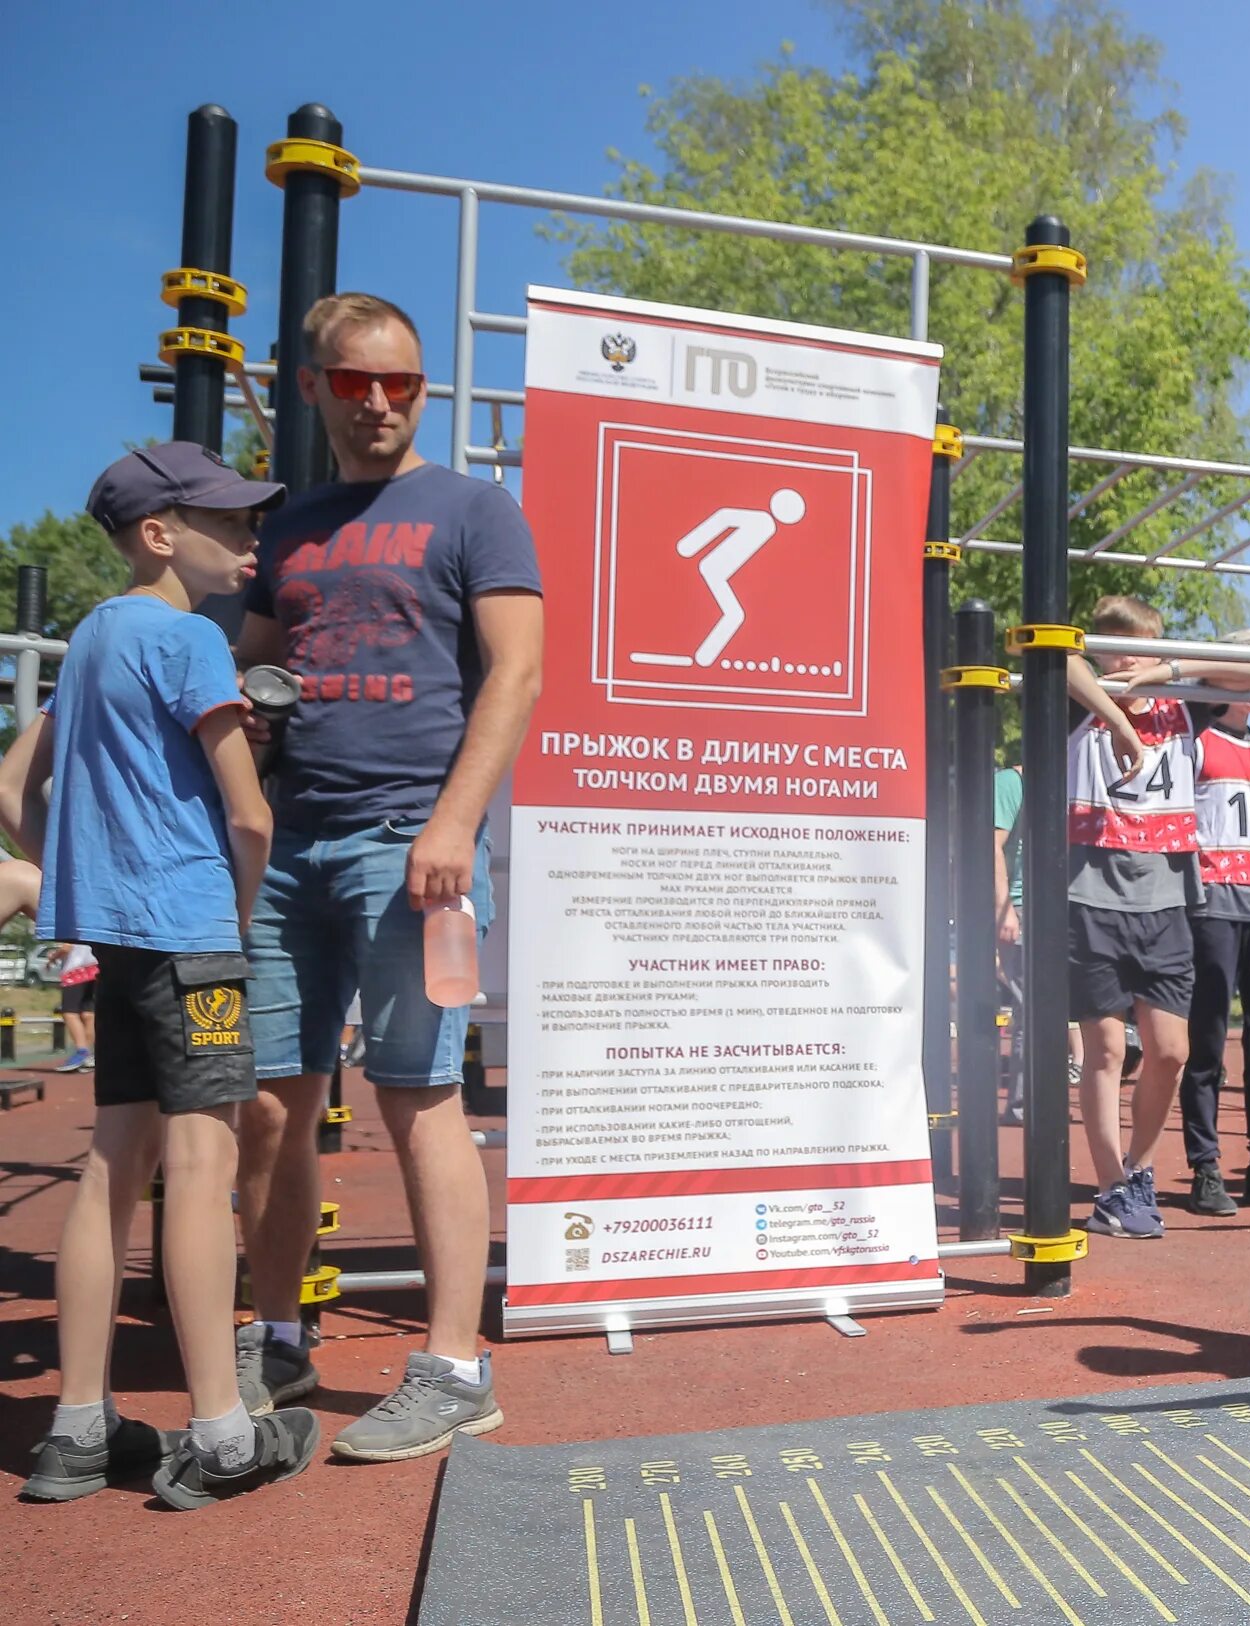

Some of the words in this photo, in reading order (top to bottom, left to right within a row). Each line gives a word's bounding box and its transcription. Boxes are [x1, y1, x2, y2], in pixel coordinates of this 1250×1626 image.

[686, 345, 757, 398] ГТО
[541, 732, 670, 761] ПРЫЖОК
[676, 737, 694, 762] В
[700, 738, 799, 766] ДЛИНУ
[803, 743, 819, 767] С
[824, 743, 908, 770] МЕСТА
[572, 769, 687, 793] ТОЛЧКОМ
[693, 773, 778, 796] ДВУМЯ
[785, 777, 878, 800] НОГАМИ
[537, 821, 621, 837] УЧАСТНИК
[626, 823, 725, 840] ПРИНИМАЕТ
[729, 825, 810, 842] ИСХОДНОЕ
[814, 827, 910, 844] ПОЛОЖЕНИЕ:
[628, 959, 710, 972] УЧАСТНИК
[714, 959, 768, 972] ИМЕЕТ
[772, 958, 825, 971] ПРАВО:
[191, 1031, 240, 1046] SPORT
[605, 1045, 684, 1060] ПОПЫТКА
[688, 1045, 709, 1059] НЕ
[713, 1042, 846, 1058] ЗАСЧИТЫВАЕТСЯ:
[603, 1216, 713, 1235] +79200036111
[602, 1246, 711, 1265] DSZARECHIE.RU
[1100, 1415, 1150, 1435] 200
[1161, 1409, 1209, 1428] 190
[976, 1428, 1025, 1450] 220
[1038, 1421, 1088, 1443] 210
[847, 1442, 892, 1463] 240
[912, 1435, 959, 1456] 230
[710, 1455, 752, 1478] 260
[779, 1448, 823, 1471] 250
[569, 1467, 606, 1492] 280
[641, 1461, 680, 1485] 270
